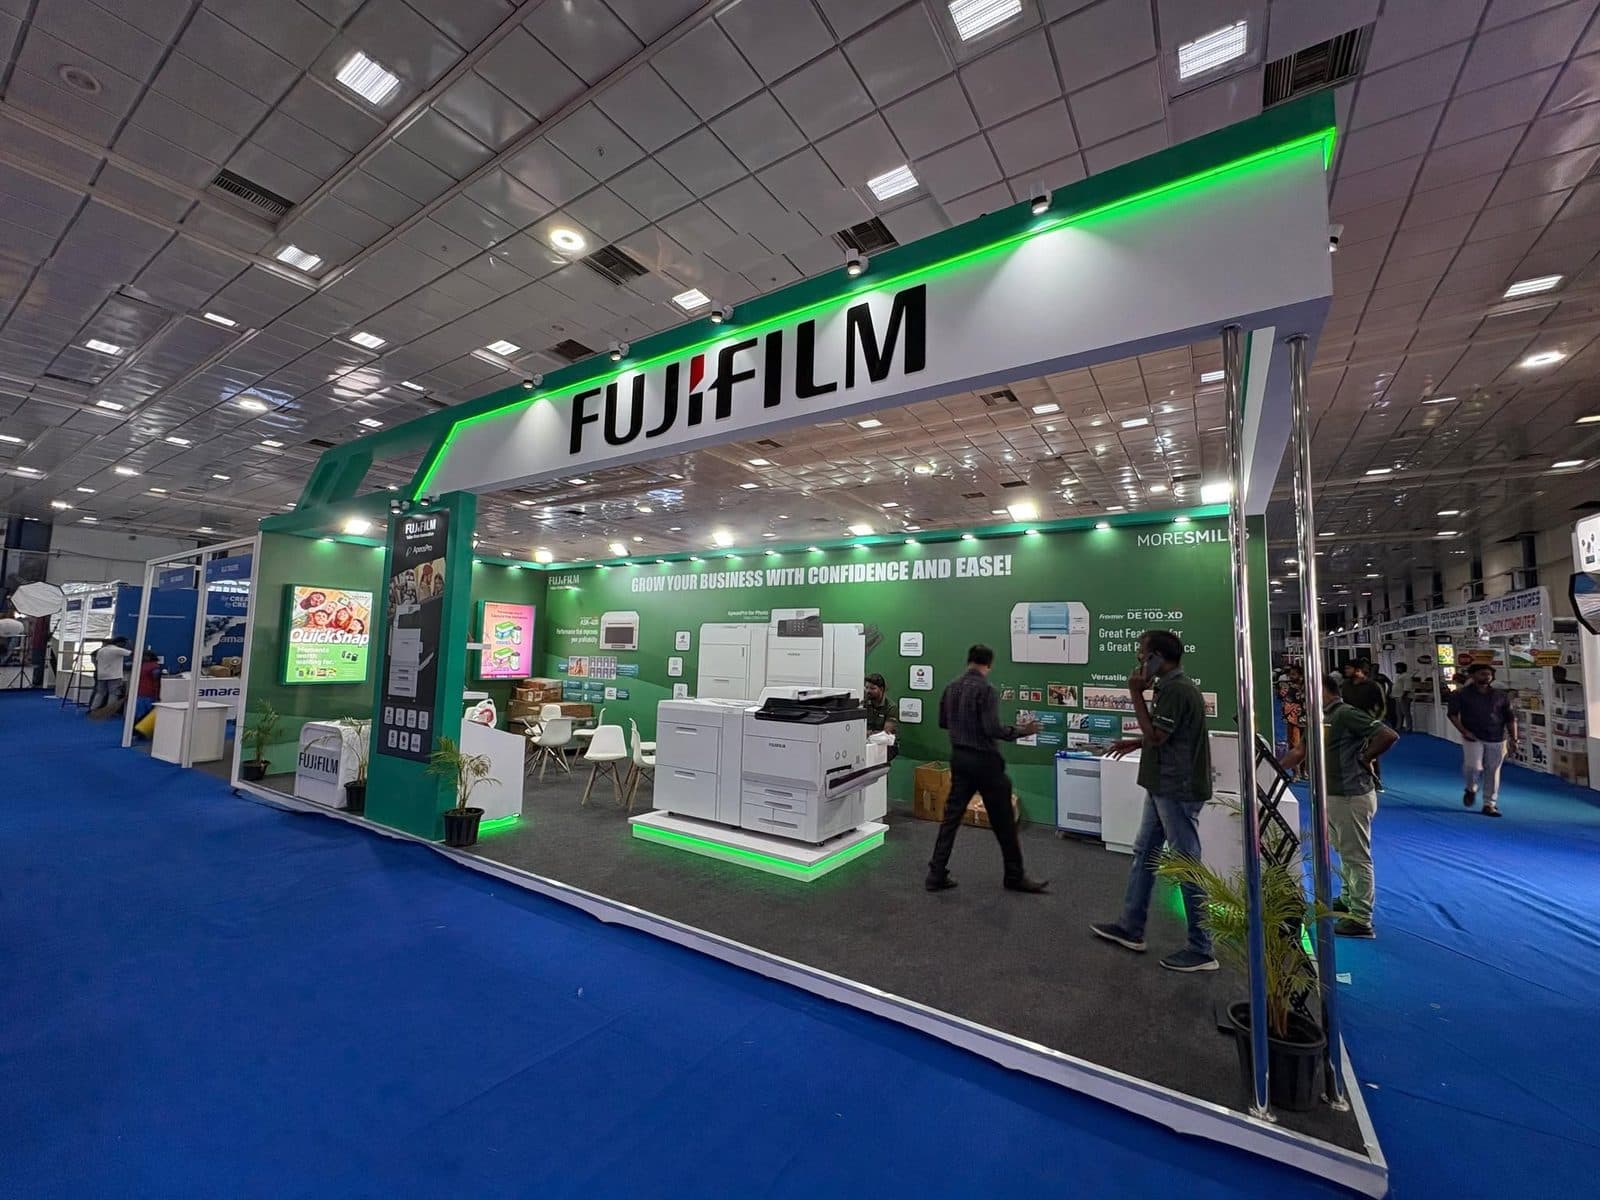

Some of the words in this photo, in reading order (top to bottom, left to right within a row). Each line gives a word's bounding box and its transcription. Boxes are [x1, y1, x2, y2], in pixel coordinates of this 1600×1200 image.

[569, 284, 926, 455] FUJIFILM
[405, 519, 437, 535] FUJIFILM
[1137, 528, 1250, 547] MORESMILS
[548, 574, 580, 585] FUJIFILM
[631, 576, 665, 592] GROW
[667, 574, 697, 591] YOUR
[700, 570, 763, 589] BUSINESS
[766, 567, 805, 587] WITH
[808, 560, 909, 585] CONFIDENCE
[912, 558, 951, 580] AND
[956, 554, 1012, 578] EASE!
[1127, 611, 1142, 620] DE
[1144, 611, 1184, 620] 100-XD
[290, 628, 369, 647] QuickSnap
[1099, 628, 1123, 639] Great
[1099, 643, 1105, 652] a
[1107, 641, 1132, 652] Great
[1091, 673, 1128, 682] Versatile
[298, 752, 339, 774] FUJIFILM
